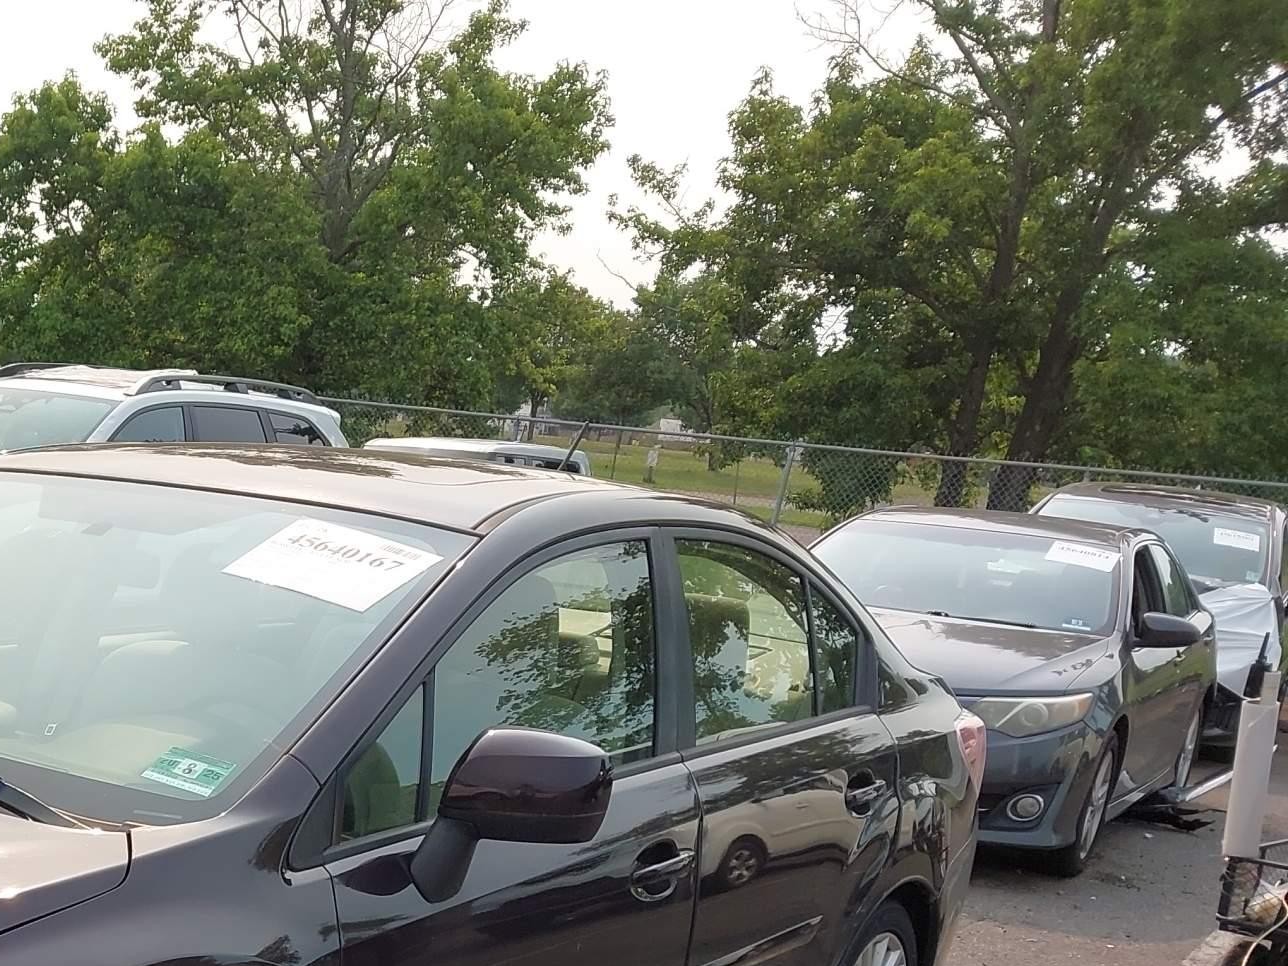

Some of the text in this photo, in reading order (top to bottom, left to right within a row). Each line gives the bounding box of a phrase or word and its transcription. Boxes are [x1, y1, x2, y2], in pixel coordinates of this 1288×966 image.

[288, 533, 405, 572] 45640167
[182, 762, 197, 775] 8
[203, 769, 224, 781] 25
